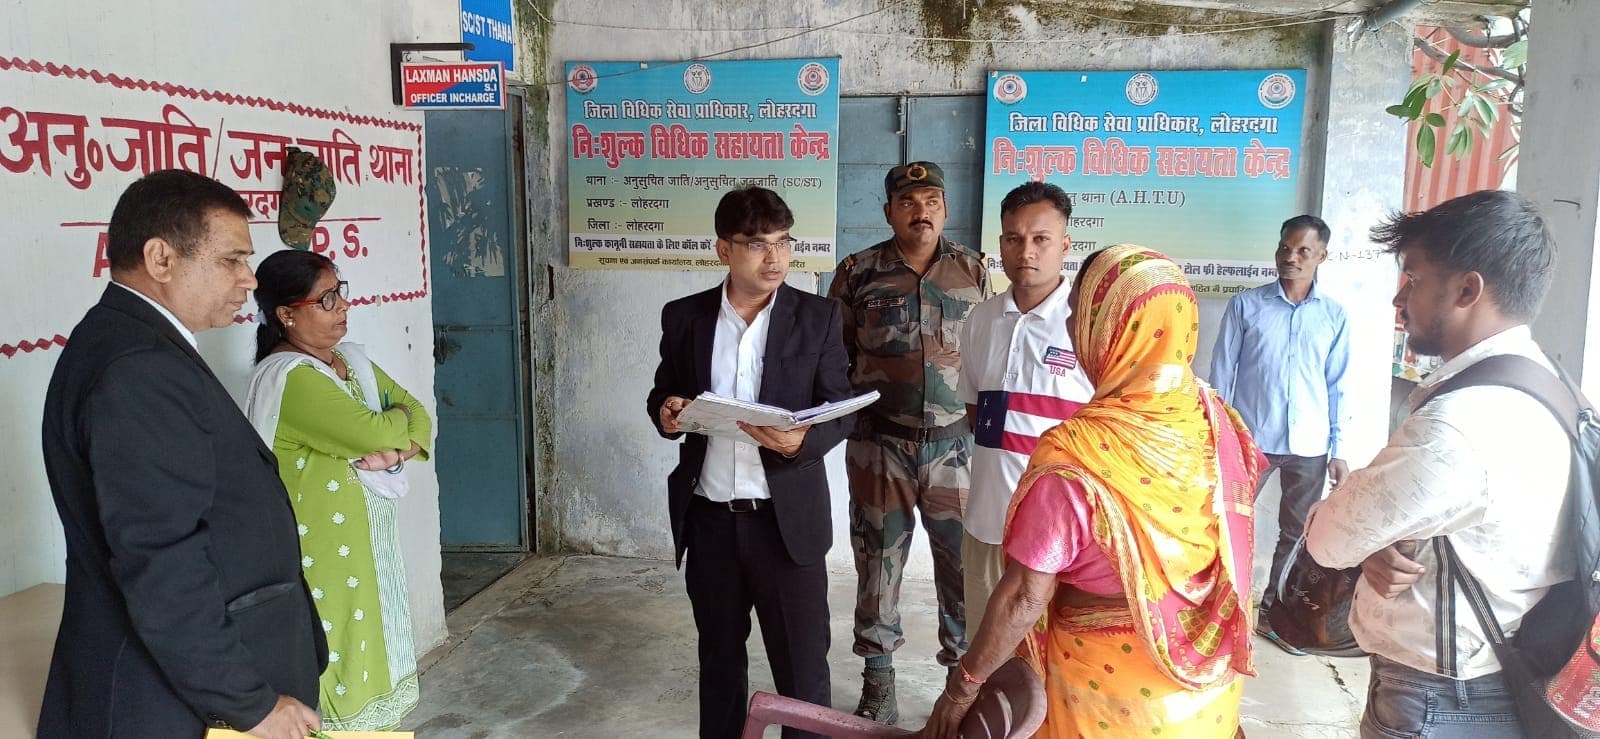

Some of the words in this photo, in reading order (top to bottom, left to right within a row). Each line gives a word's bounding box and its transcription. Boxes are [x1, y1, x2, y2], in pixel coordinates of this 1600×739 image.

[487, 18, 513, 44] THANA
[405, 69, 450, 83] LAXMAN
[453, 68, 498, 83] HANSDA
[410, 93, 448, 103] OFFICER
[449, 92, 495, 103] INCHARGE
[584, 99, 618, 119] जिला
[621, 99, 662, 119] विधिक
[666, 99, 691, 119] सेवा
[695, 99, 754, 122] प्राधिकार,
[758, 98, 817, 119] लोहरदगा
[1008, 112, 1048, 132] जिला
[1051, 111, 1099, 132] विधिक
[1103, 111, 1132, 132] सेवा
[1136, 111, 1204, 136] प्राधिकार,
[1210, 112, 1278, 133] लोहरदगा
[650, 123, 709, 160] विधिक
[714, 131, 784, 160] सहायता
[789, 123, 830, 160] केन्द्र
[369, 144, 414, 185] थाना
[1083, 137, 1150, 176] विधिक
[1156, 146, 1237, 178] सहायता
[1244, 138, 1291, 180] केन्द्र
[585, 175, 606, 186] थाना
[782, 177, 822, 189] (SC/ST)
[630, 196, 670, 210] लोहरदगा
[1081, 193, 1106, 203] थाना
[1110, 190, 1186, 208] (A.H.T.U)
[587, 218, 610, 230] जिला
[625, 219, 664, 232] लोहरदगा
[665, 238, 680, 250] लिए
[1049, 365, 1066, 377] USA
